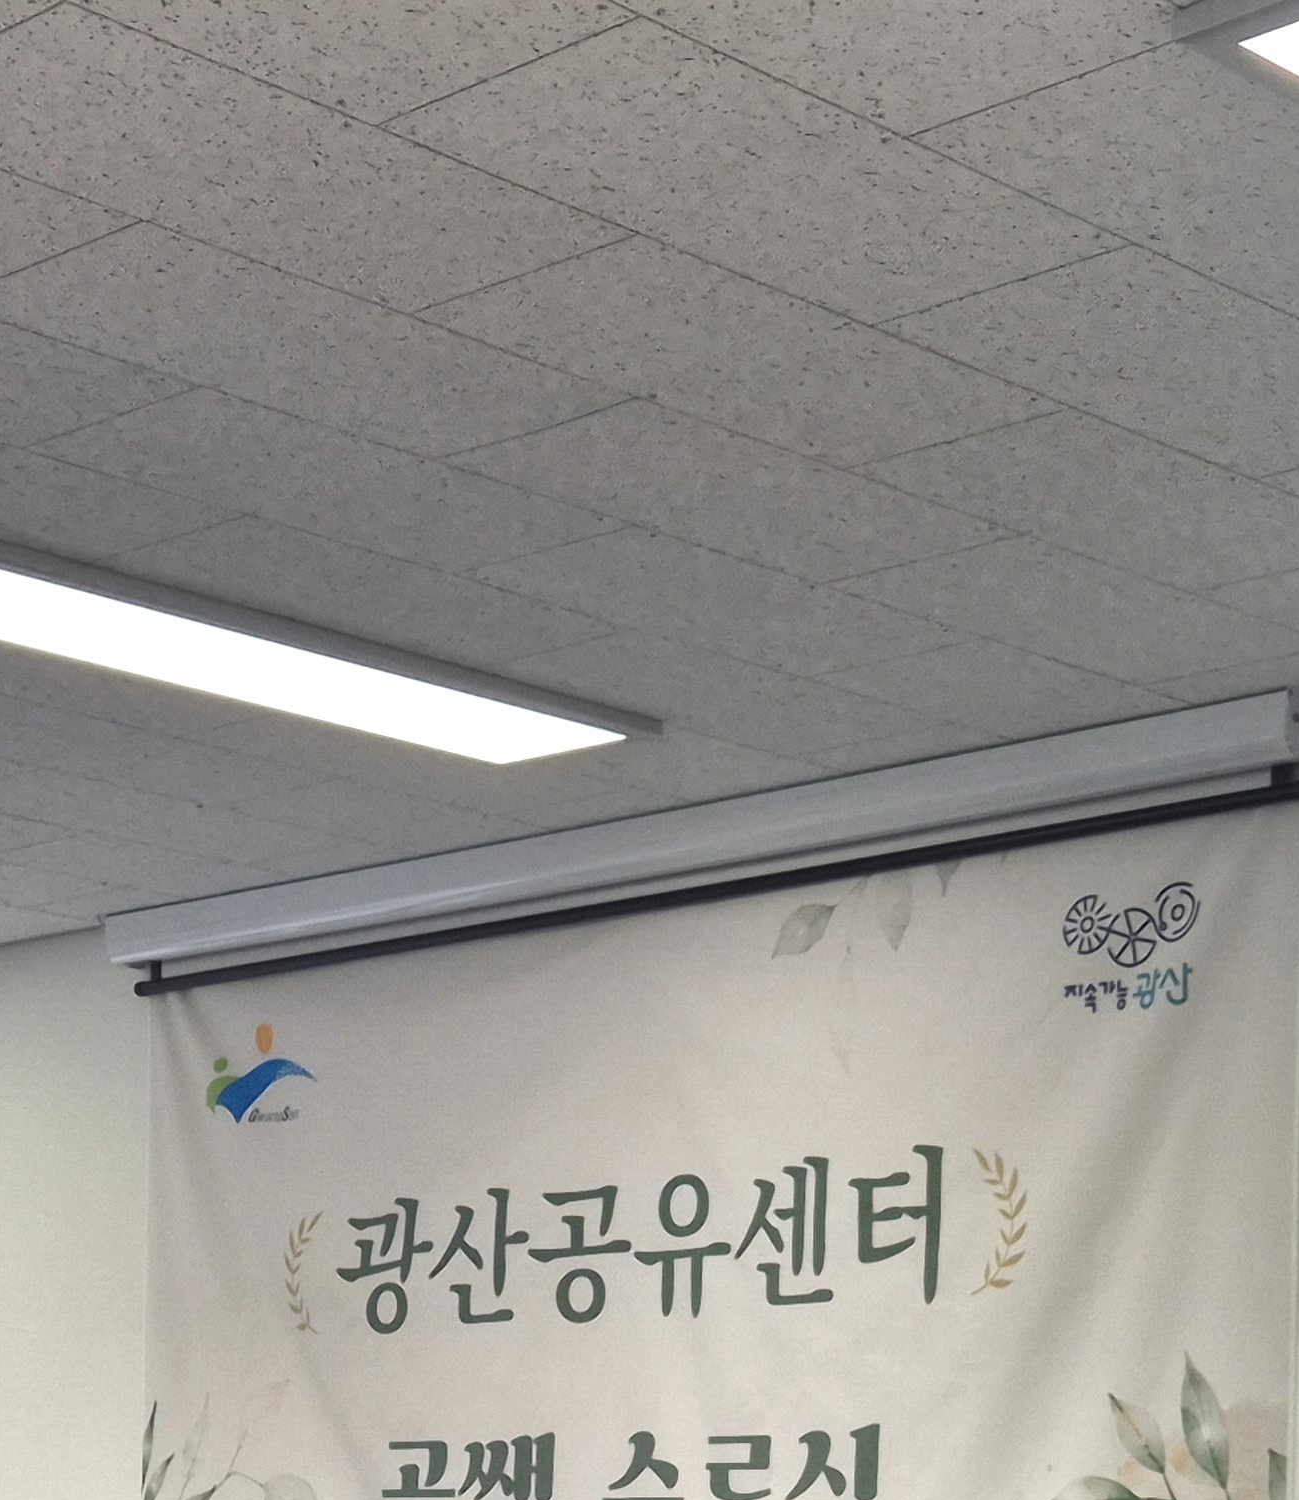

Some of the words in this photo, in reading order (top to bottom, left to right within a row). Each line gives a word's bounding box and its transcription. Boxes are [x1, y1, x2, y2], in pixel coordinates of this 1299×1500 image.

[1064, 979, 1128, 1014] 지속가능
[1133, 962, 1193, 1010] 광산
[335, 1144, 944, 1335] 광산공유센터
